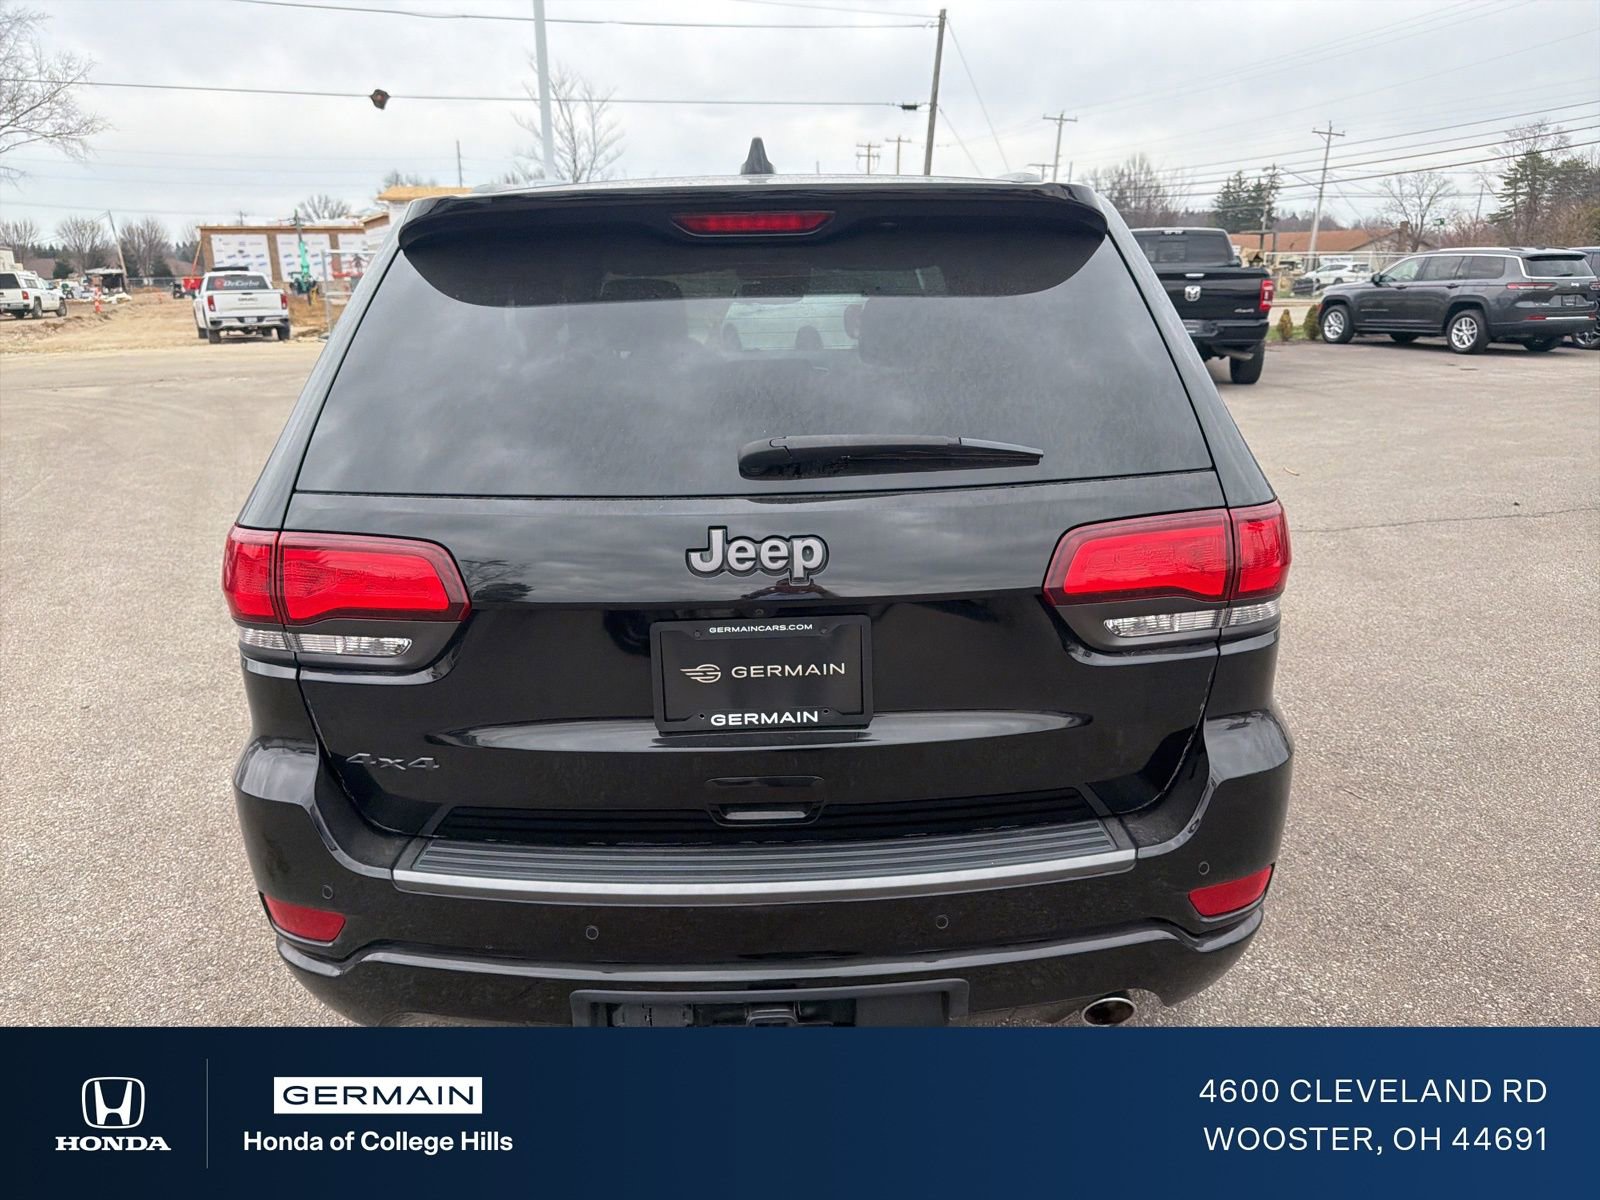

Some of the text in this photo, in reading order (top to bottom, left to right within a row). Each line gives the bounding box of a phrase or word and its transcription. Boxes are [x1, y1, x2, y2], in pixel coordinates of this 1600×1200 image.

[687, 527, 827, 583] Jeep
[708, 623, 813, 634] GERMAINCARS.COM
[731, 662, 846, 679] GERMAIN
[710, 710, 819, 726] GERMAIN
